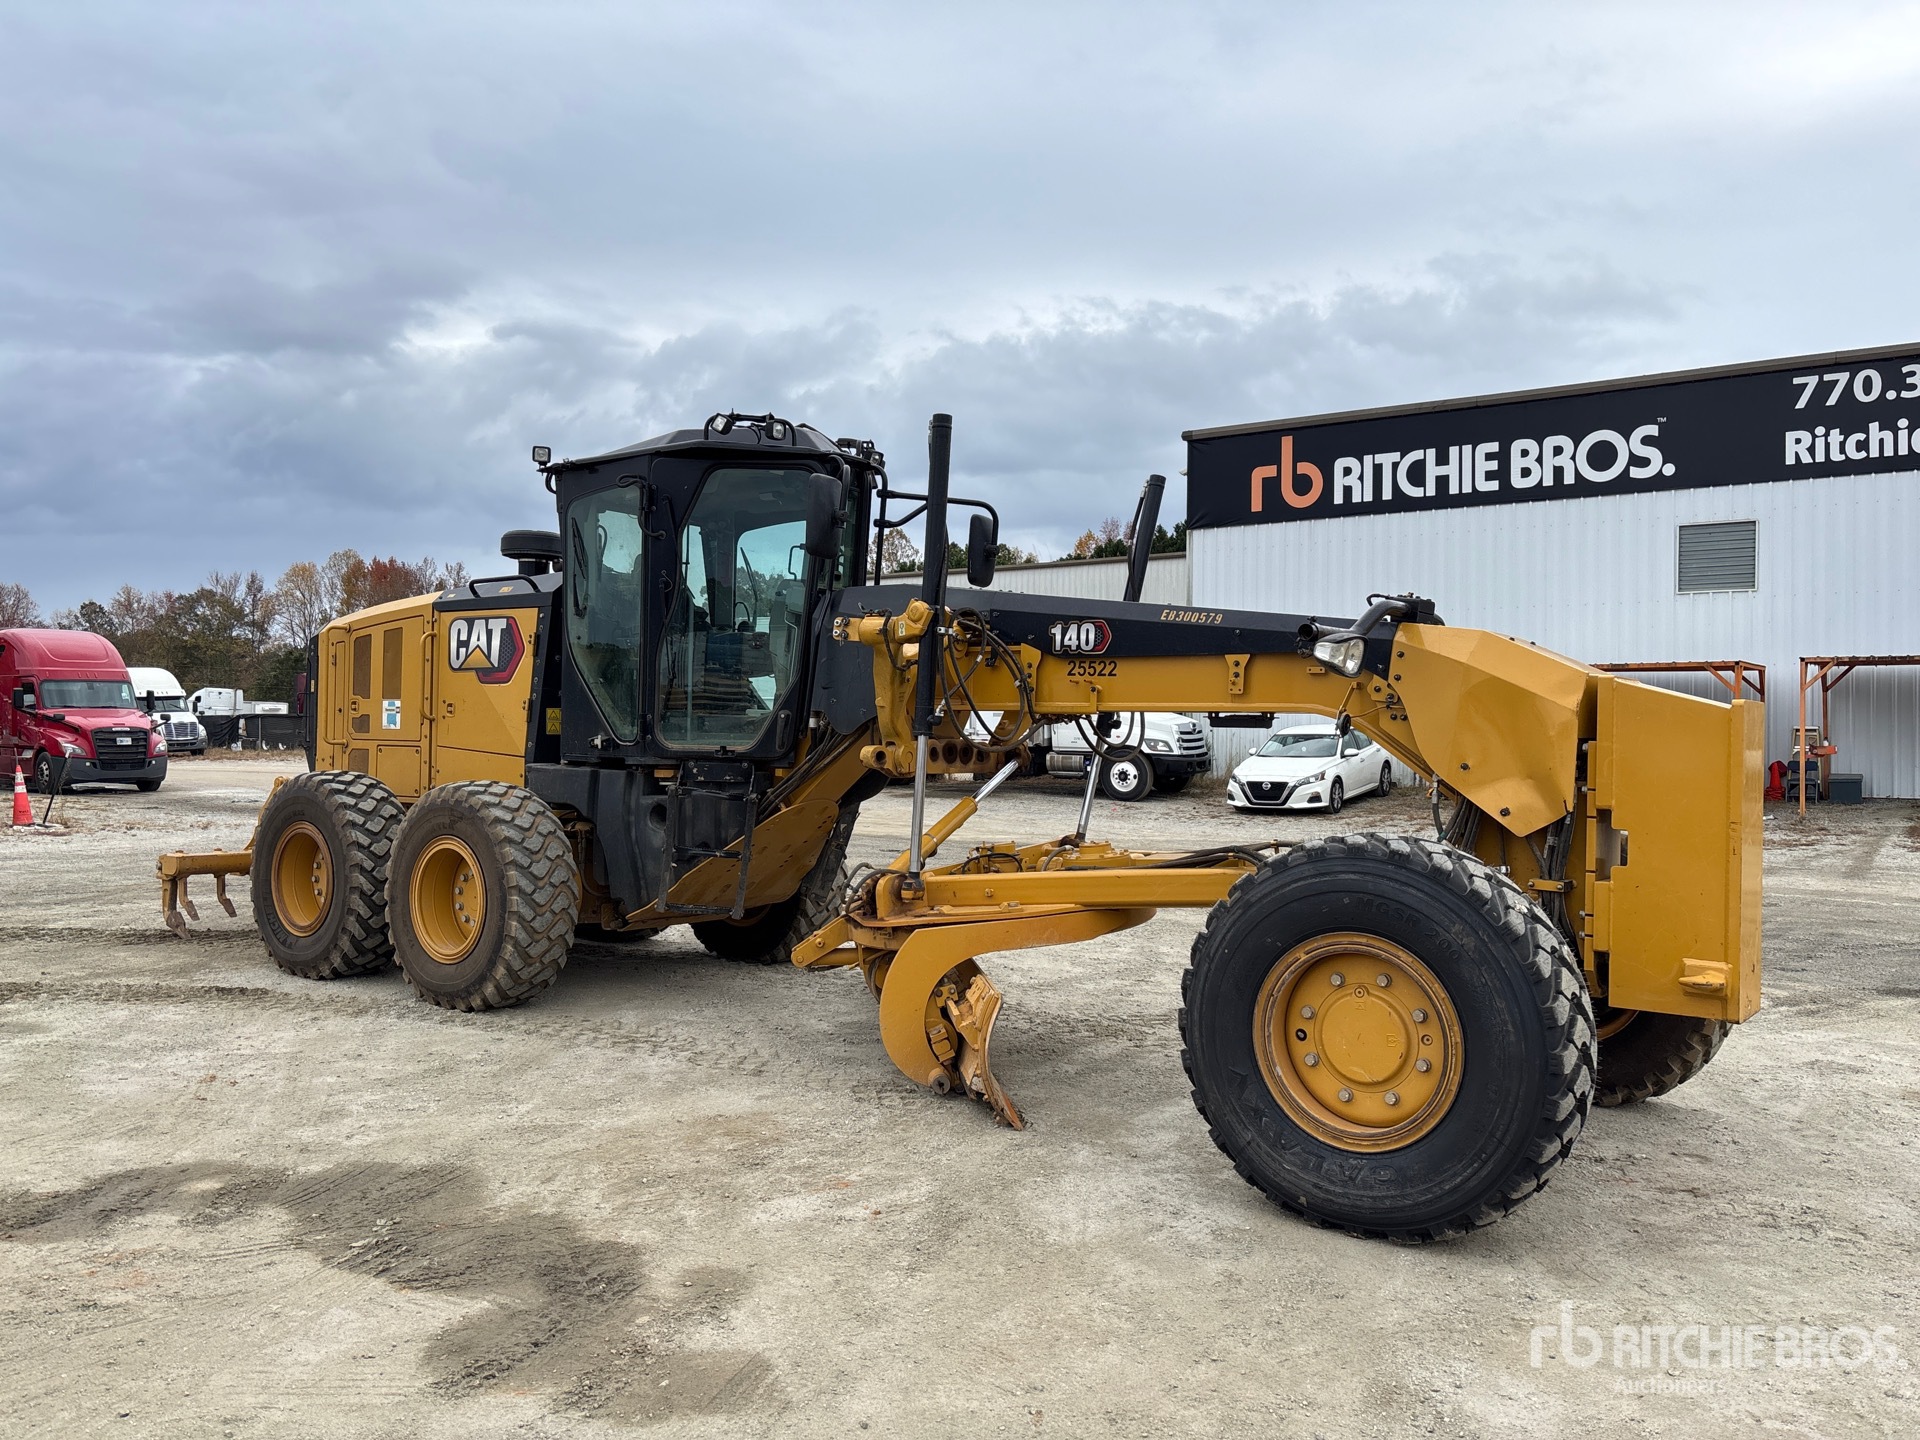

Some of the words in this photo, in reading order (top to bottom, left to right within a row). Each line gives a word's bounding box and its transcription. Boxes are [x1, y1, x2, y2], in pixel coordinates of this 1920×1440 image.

[1792, 363, 1920, 410] 770.3
[1250, 435, 1324, 512] rb
[1333, 441, 1500, 505] RITCHIE
[1510, 424, 1676, 489] BROS.
[1160, 608, 1224, 625] EB300579
[450, 618, 507, 669] CAT
[1050, 621, 1096, 651] 140
[1067, 660, 1118, 677] 25522
